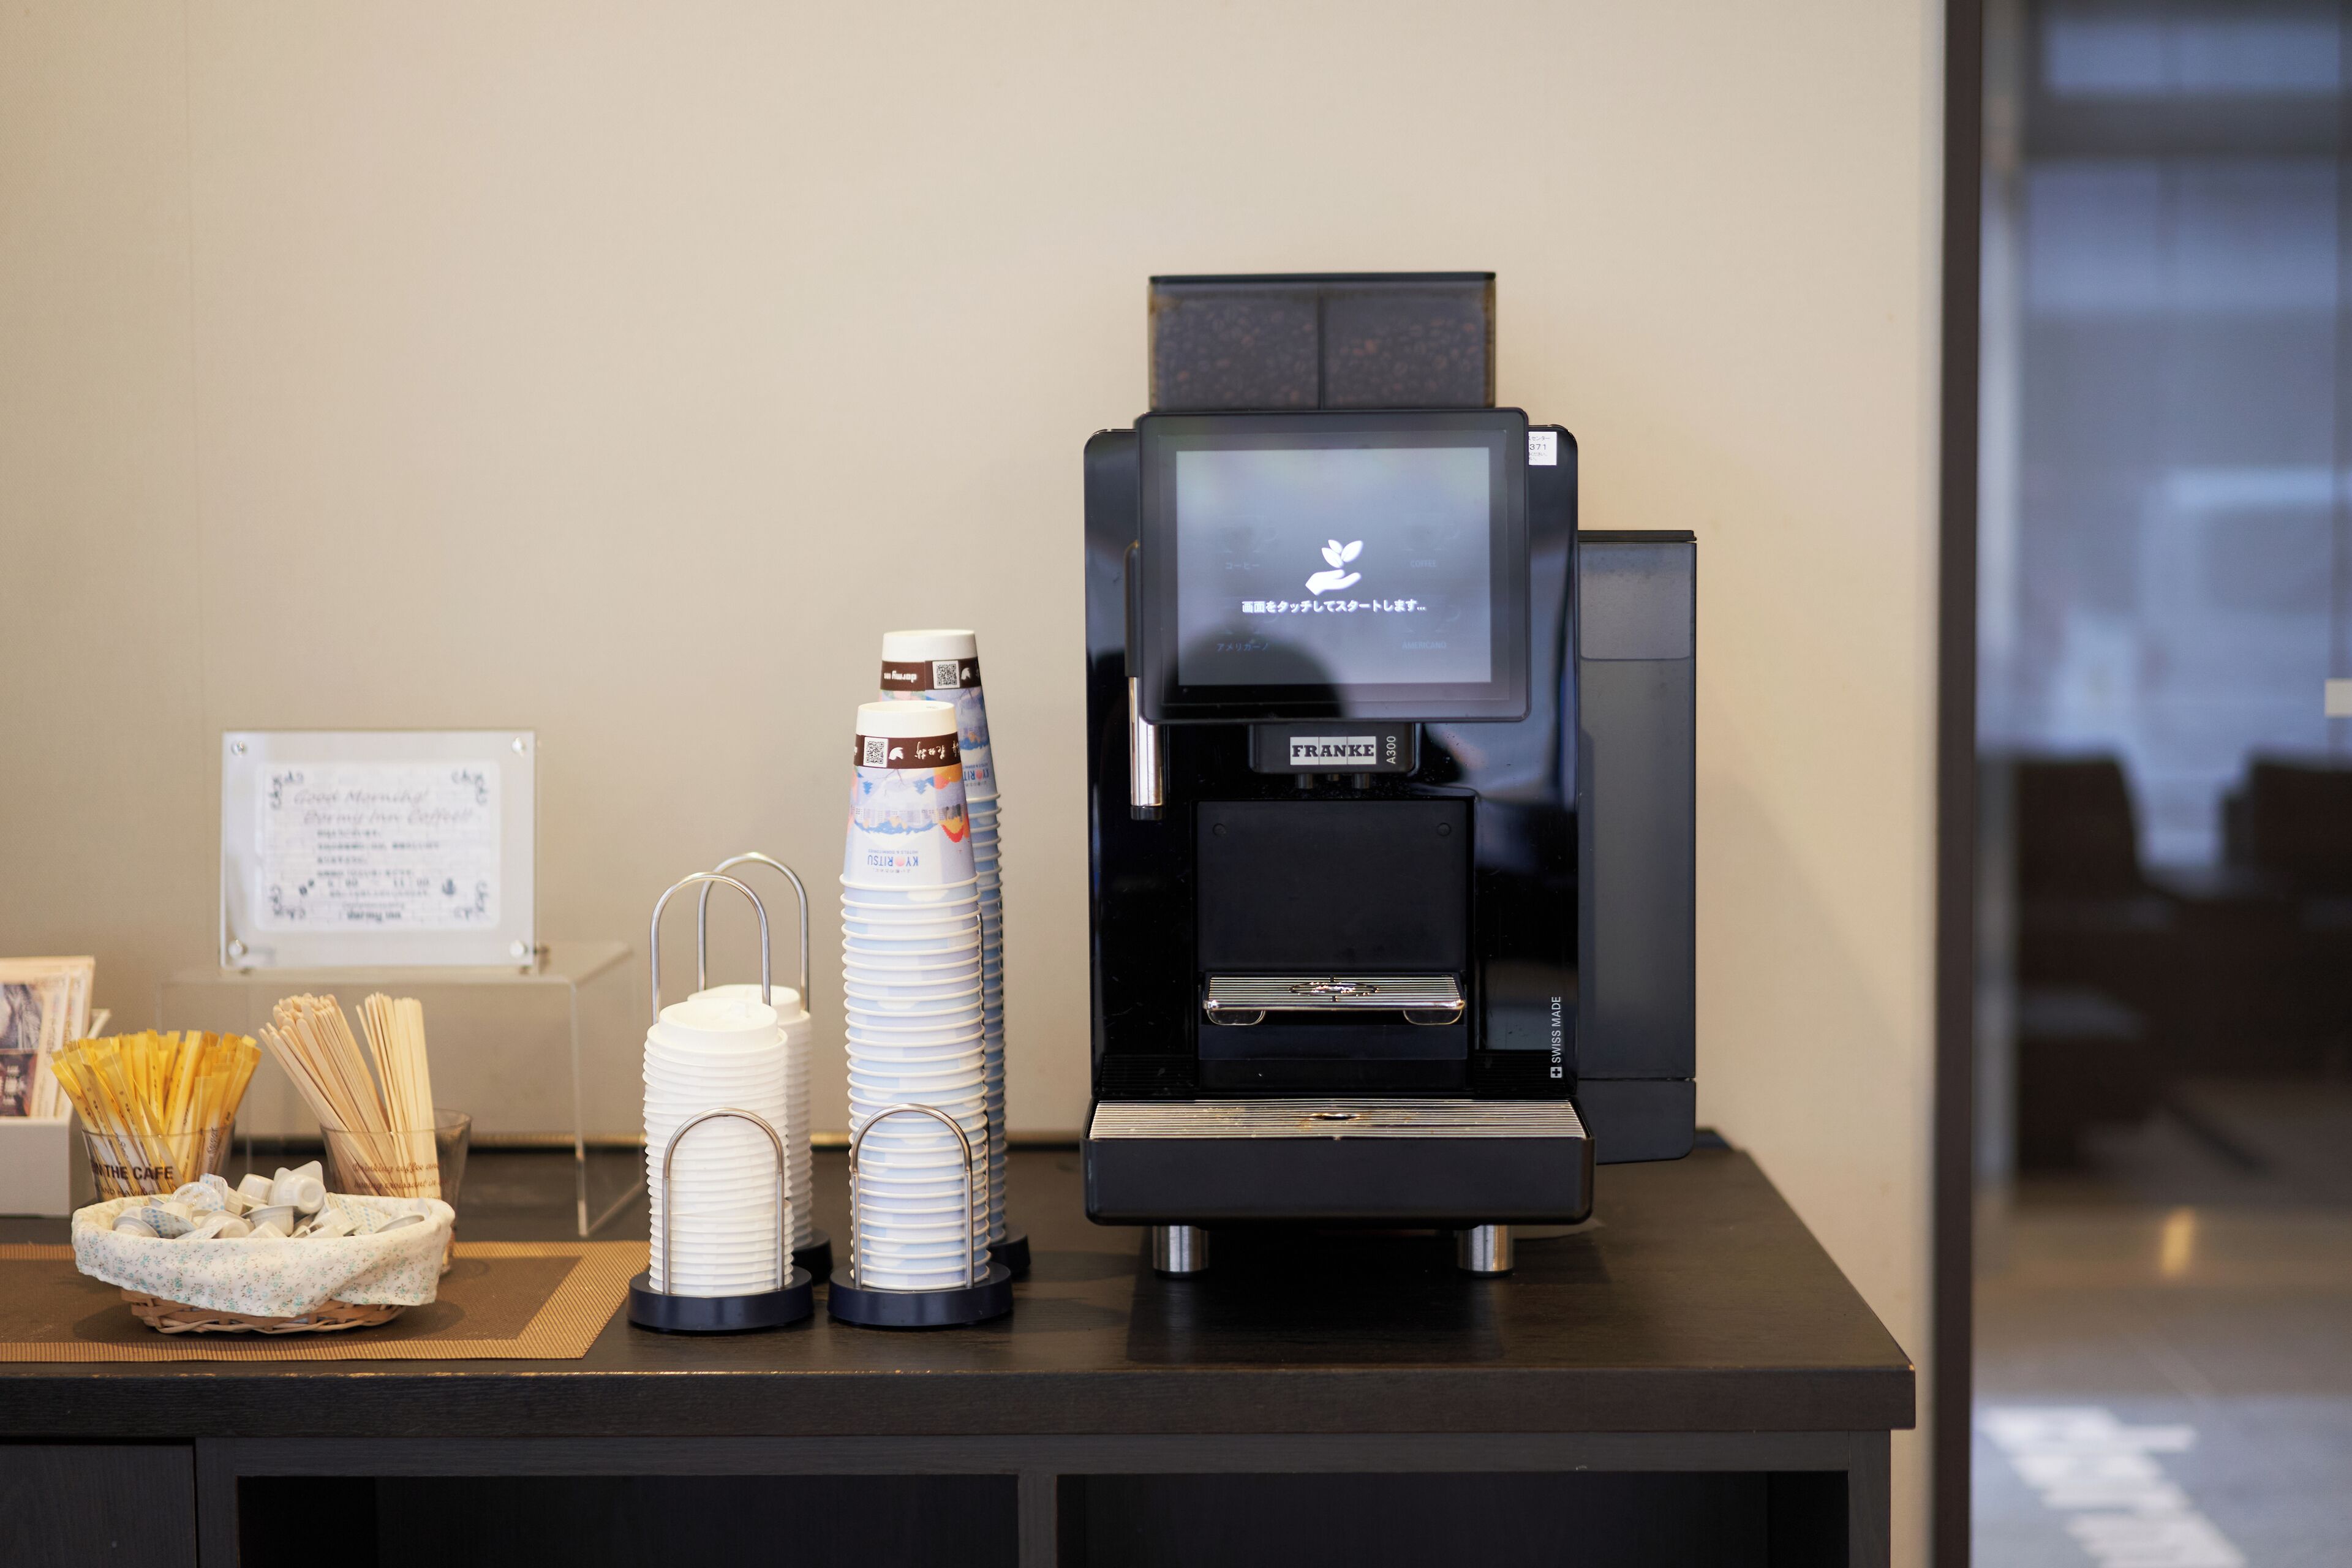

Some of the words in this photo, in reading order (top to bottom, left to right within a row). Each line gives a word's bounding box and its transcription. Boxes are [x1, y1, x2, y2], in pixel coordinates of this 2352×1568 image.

[1410, 559, 1436, 568] COFFEE
[1216, 643, 1268, 652] アメリカーノ
[892, 670, 917, 683] dormy
[1292, 744, 1374, 757] FRANKE
[1386, 736, 1396, 764] A300
[1551, 997, 1561, 1027] MADE
[1551, 1030, 1561, 1063] SWISS
[104, 1164, 128, 1179] THE
[396, 1162, 423, 1174] coffee
